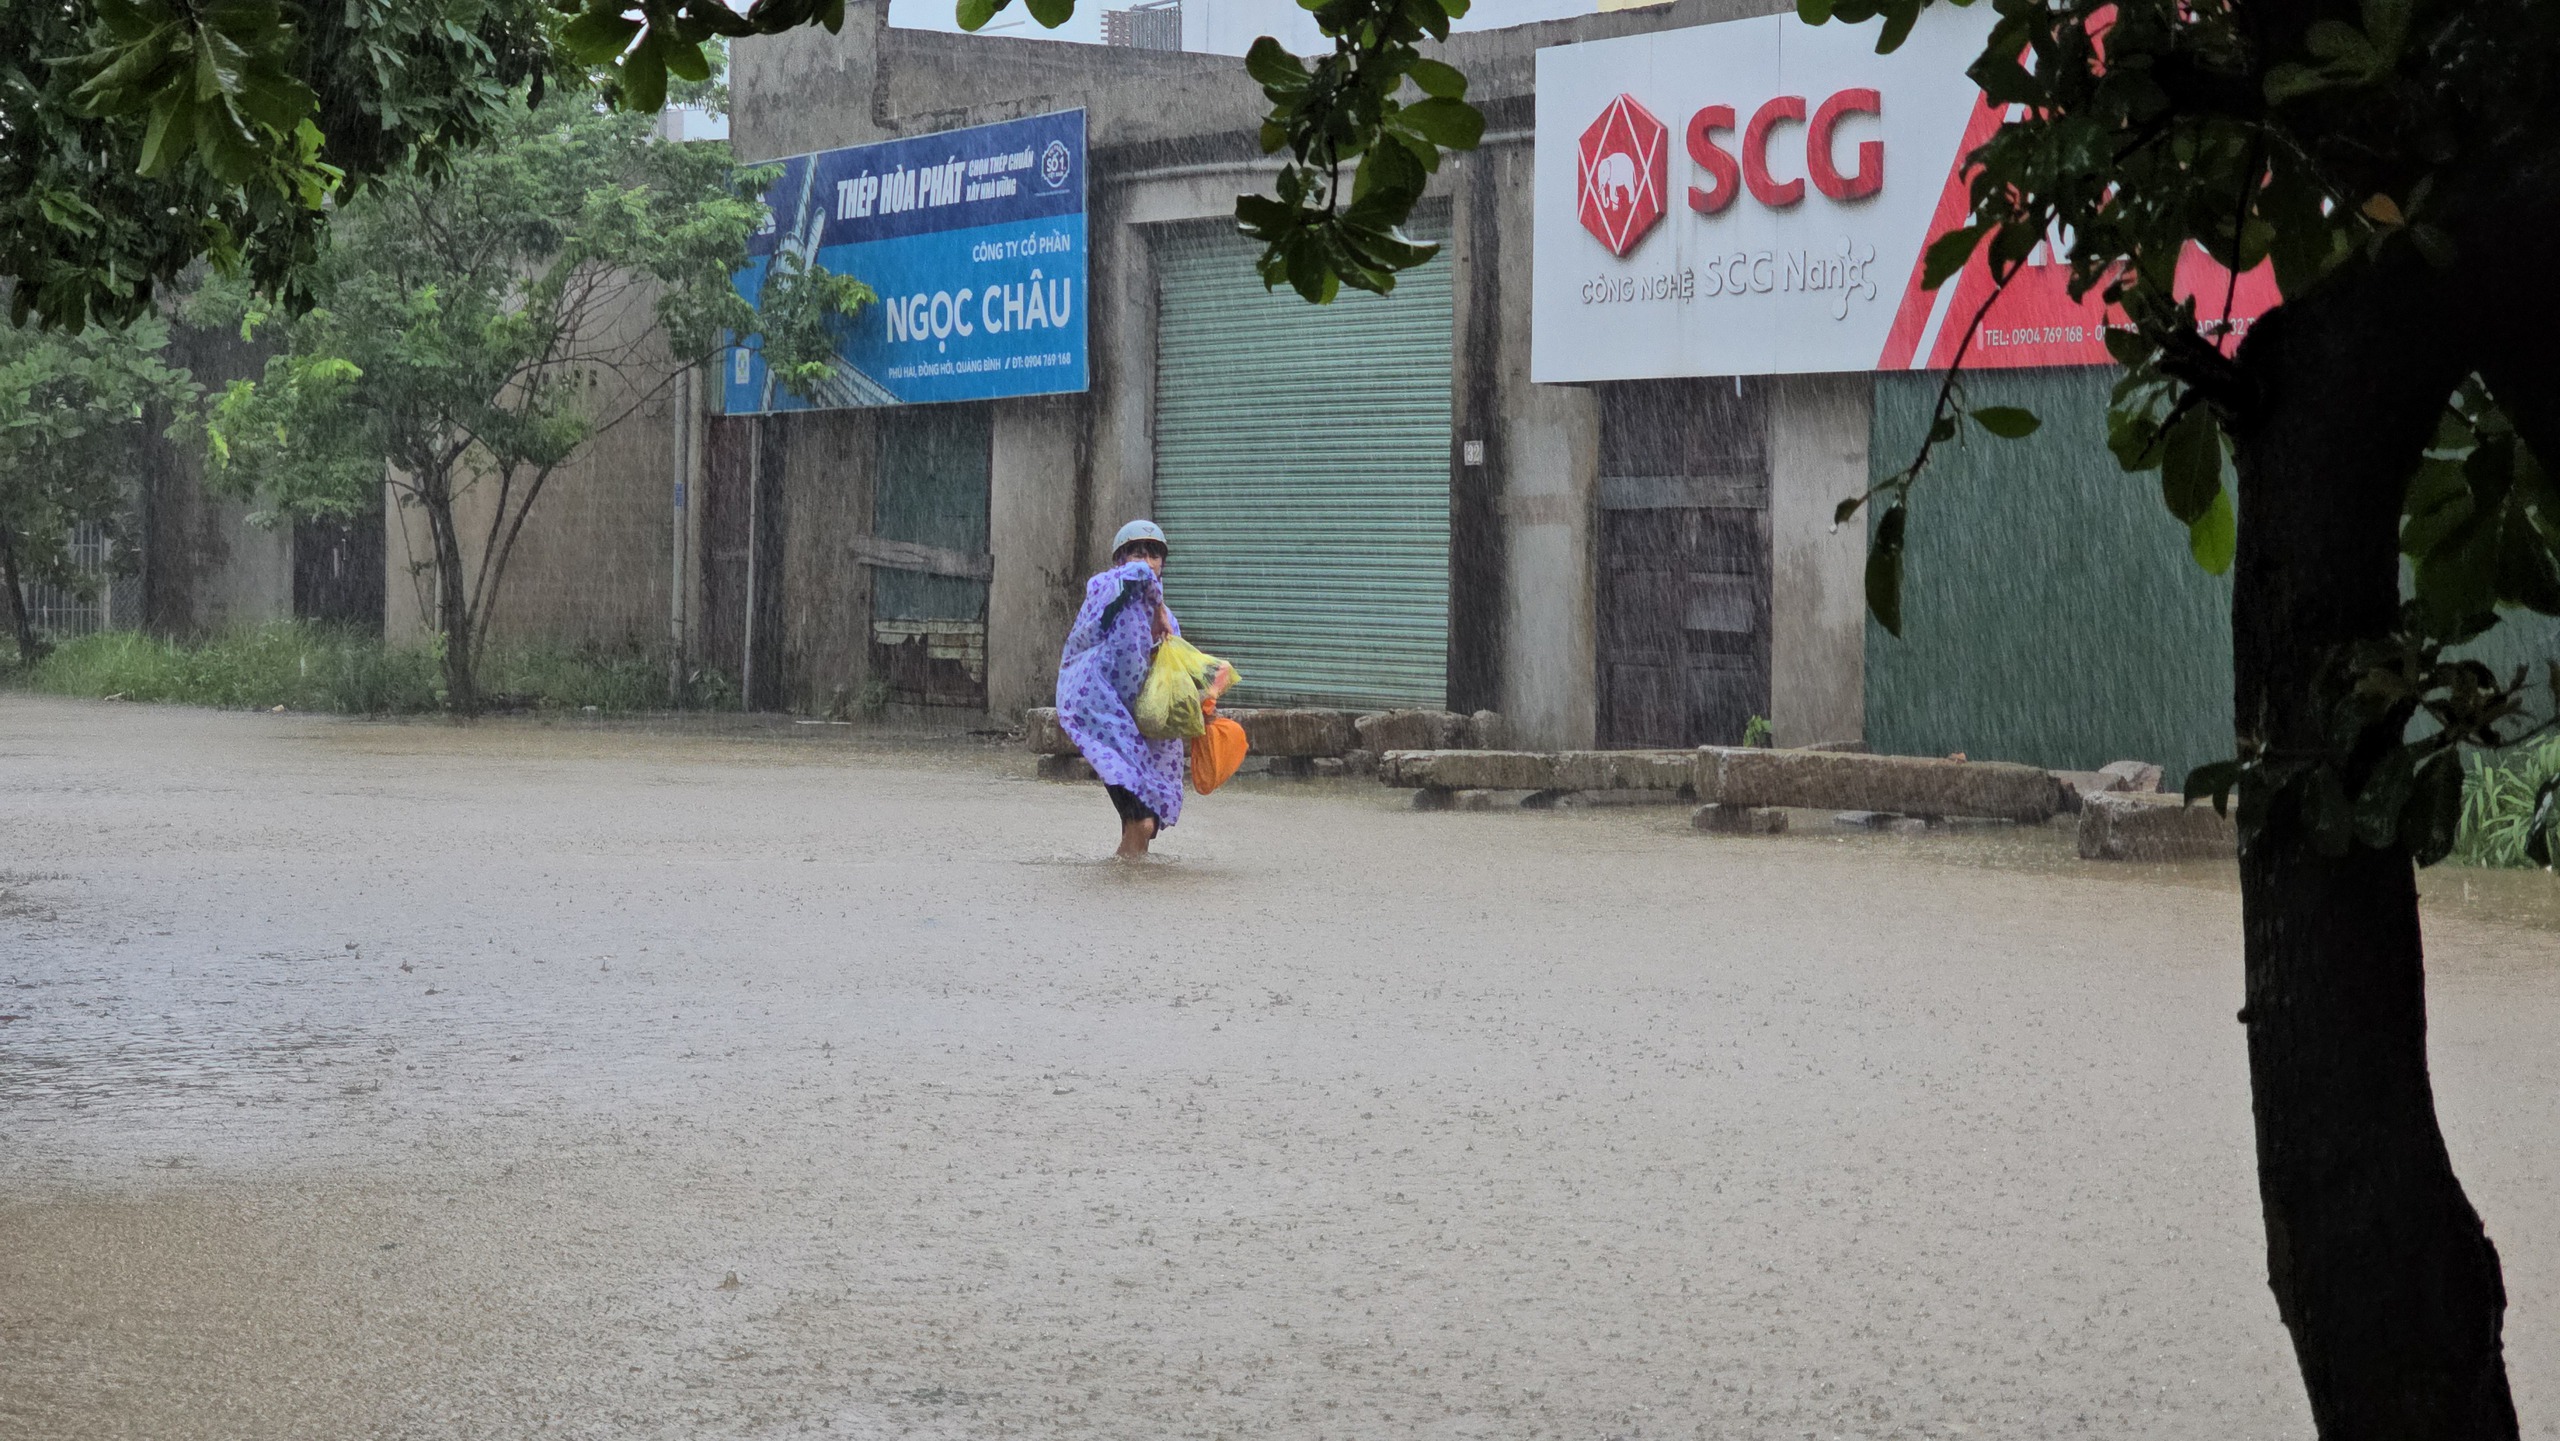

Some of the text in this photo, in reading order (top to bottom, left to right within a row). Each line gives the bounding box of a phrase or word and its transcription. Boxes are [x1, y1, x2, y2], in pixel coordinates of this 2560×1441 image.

[969, 159, 989, 180] CHỌN
[990, 152, 1008, 174] THÉP
[1686, 87, 1884, 214] SCG
[837, 156, 966, 220] THÉP HÒA PHÁT
[973, 229, 1071, 262] CÔNG TY CỔ PHẦN
[1582, 273, 1634, 305] CÔNG
[1640, 267, 1694, 304] NGHỆ
[1704, 251, 1775, 297] SCG
[887, 269, 1071, 353] NGỌC CHÂU
[1985, 329, 2009, 346] TEL:
[2012, 327, 2041, 345] 0904
[2043, 325, 2062, 344] 769
[2065, 325, 2083, 343] 168
[1025, 355, 1041, 368] 0904
[1042, 353, 1056, 367] 769
[1057, 352, 1071, 365] 168
[1467, 444, 1480, 462] 32
